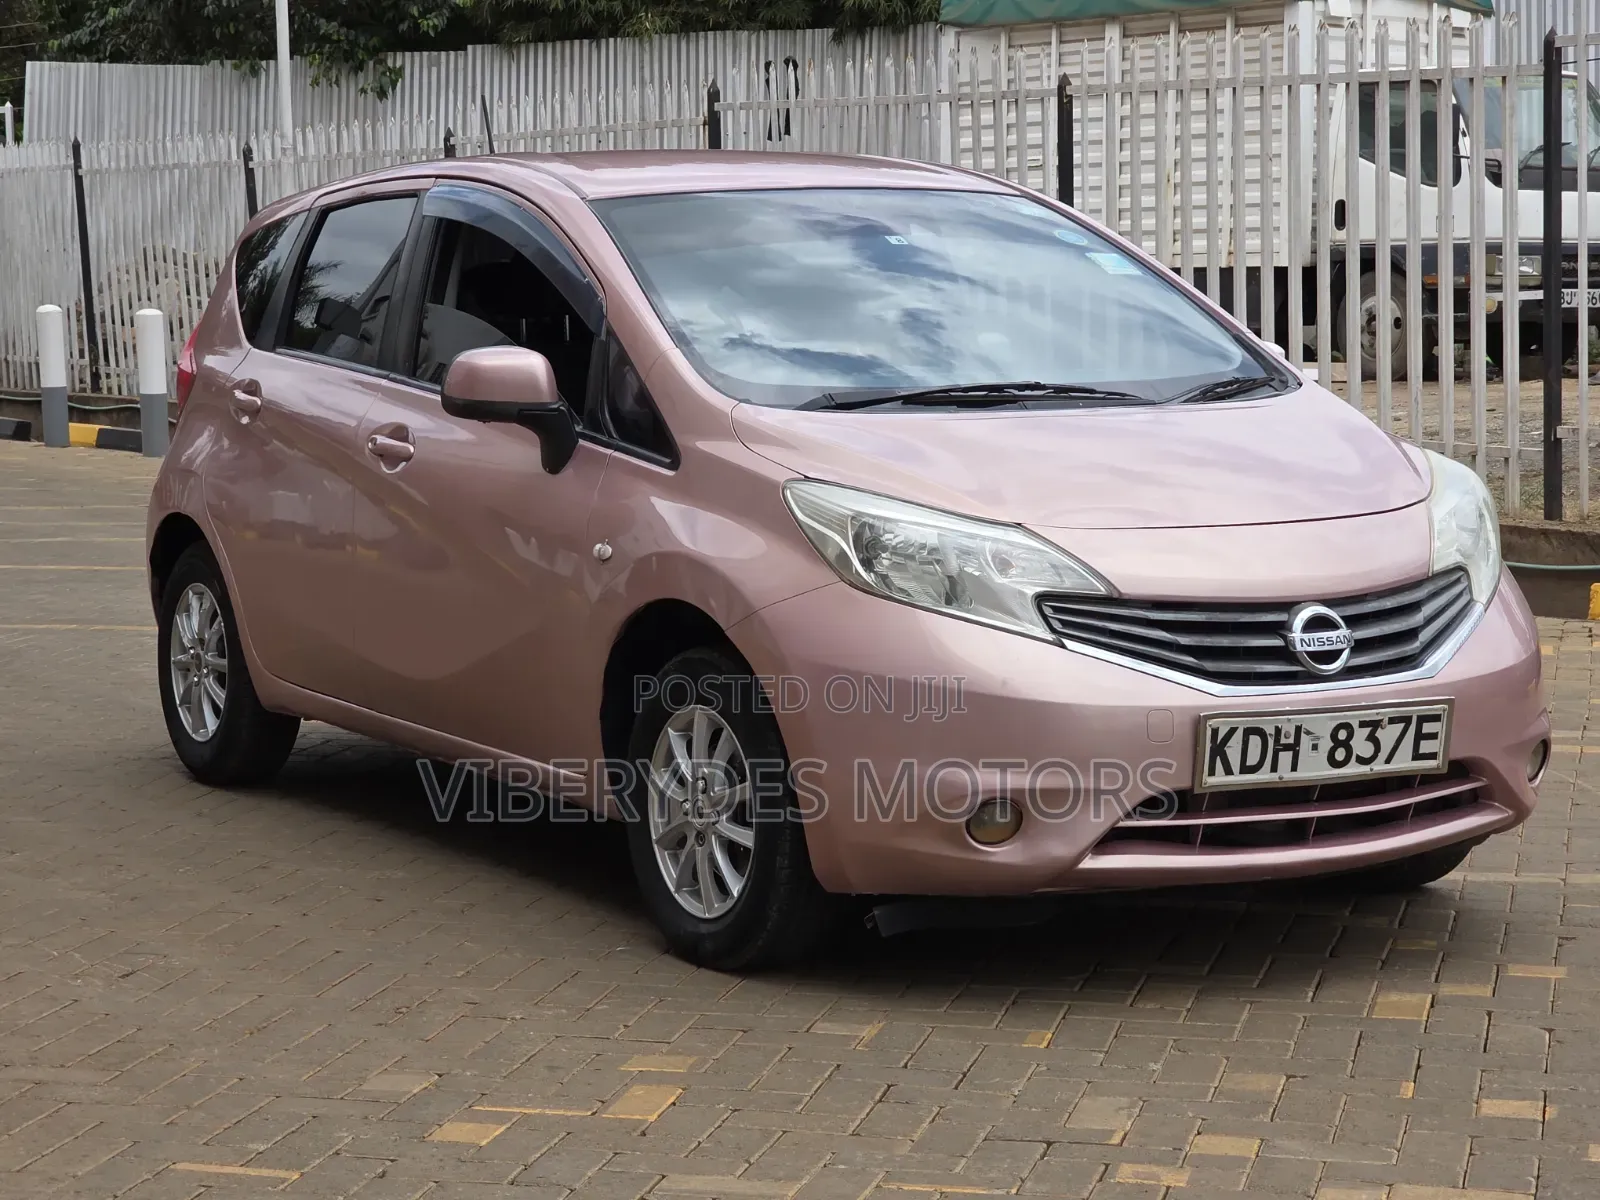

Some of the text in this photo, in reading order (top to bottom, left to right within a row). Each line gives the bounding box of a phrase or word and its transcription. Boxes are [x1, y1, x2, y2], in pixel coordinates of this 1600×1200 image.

[1300, 633, 1351, 648] NISSAN
[1207, 713, 1443, 777] KDH 837E
